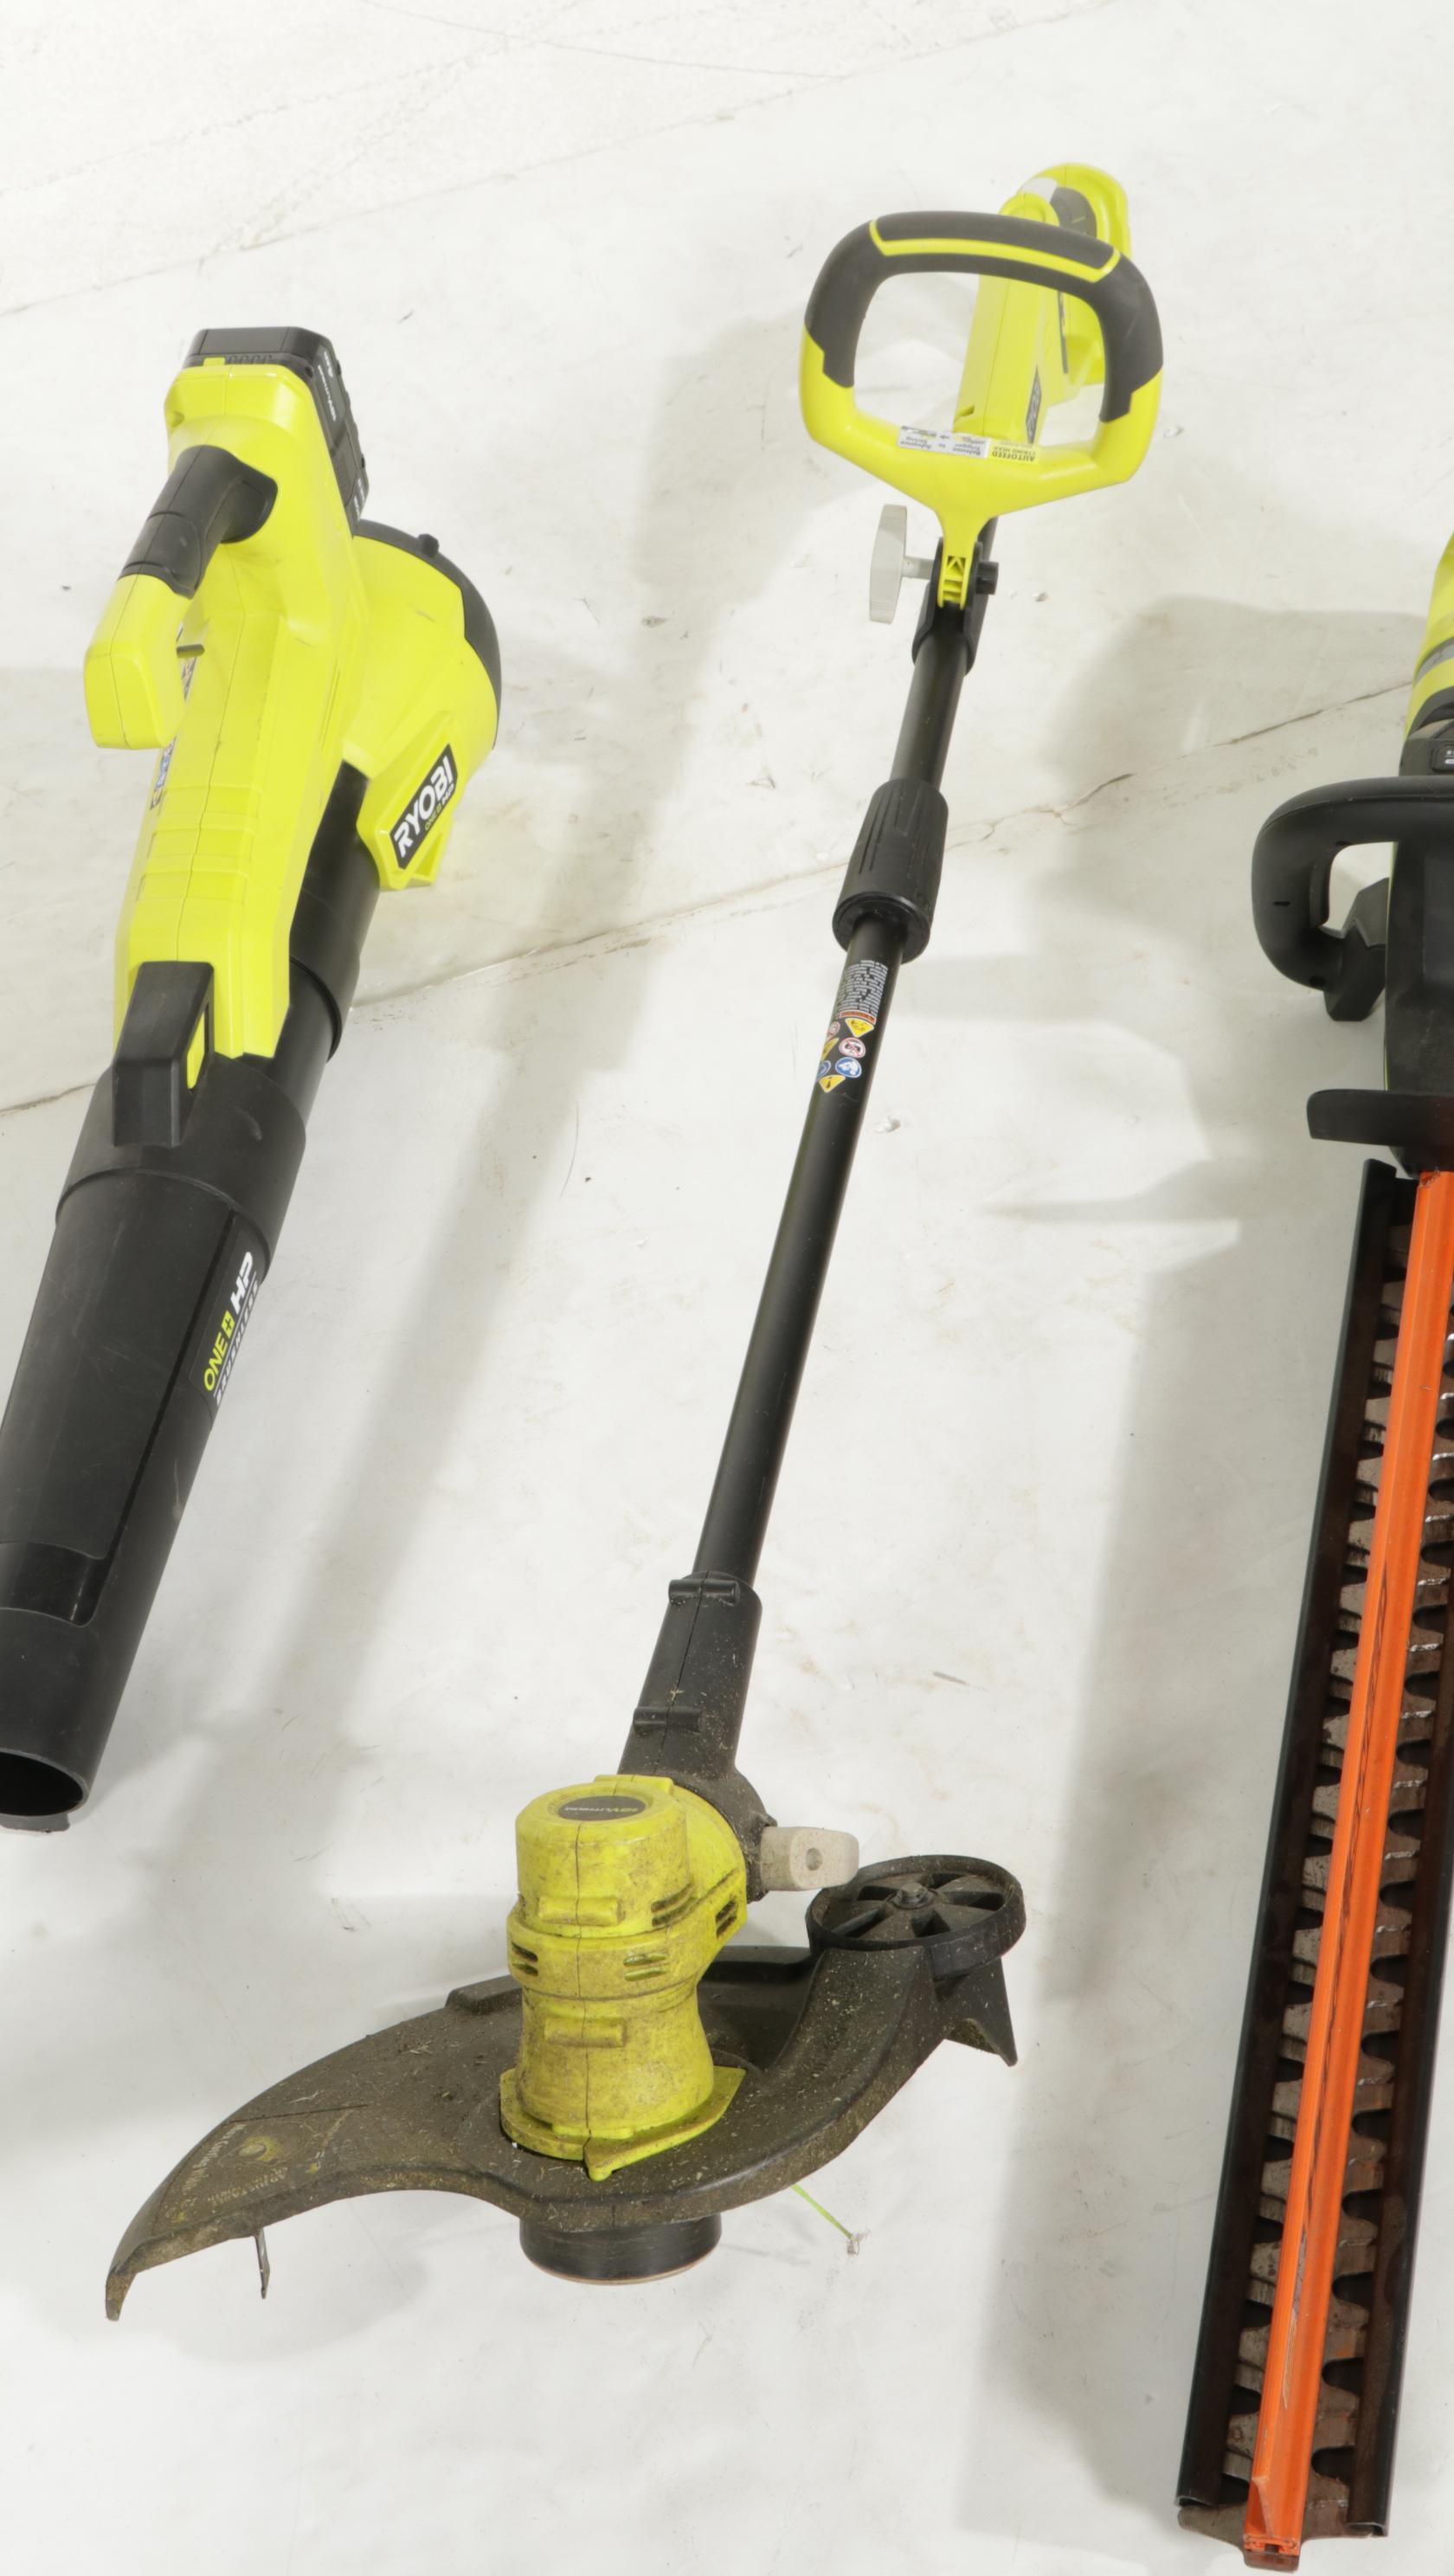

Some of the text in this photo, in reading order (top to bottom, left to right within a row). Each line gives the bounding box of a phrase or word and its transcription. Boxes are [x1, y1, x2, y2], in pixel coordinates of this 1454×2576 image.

[992, 451, 1035, 461] AUTOFEED
[394, 755, 454, 859] RYOBI
[230, 1251, 254, 1315] HP
